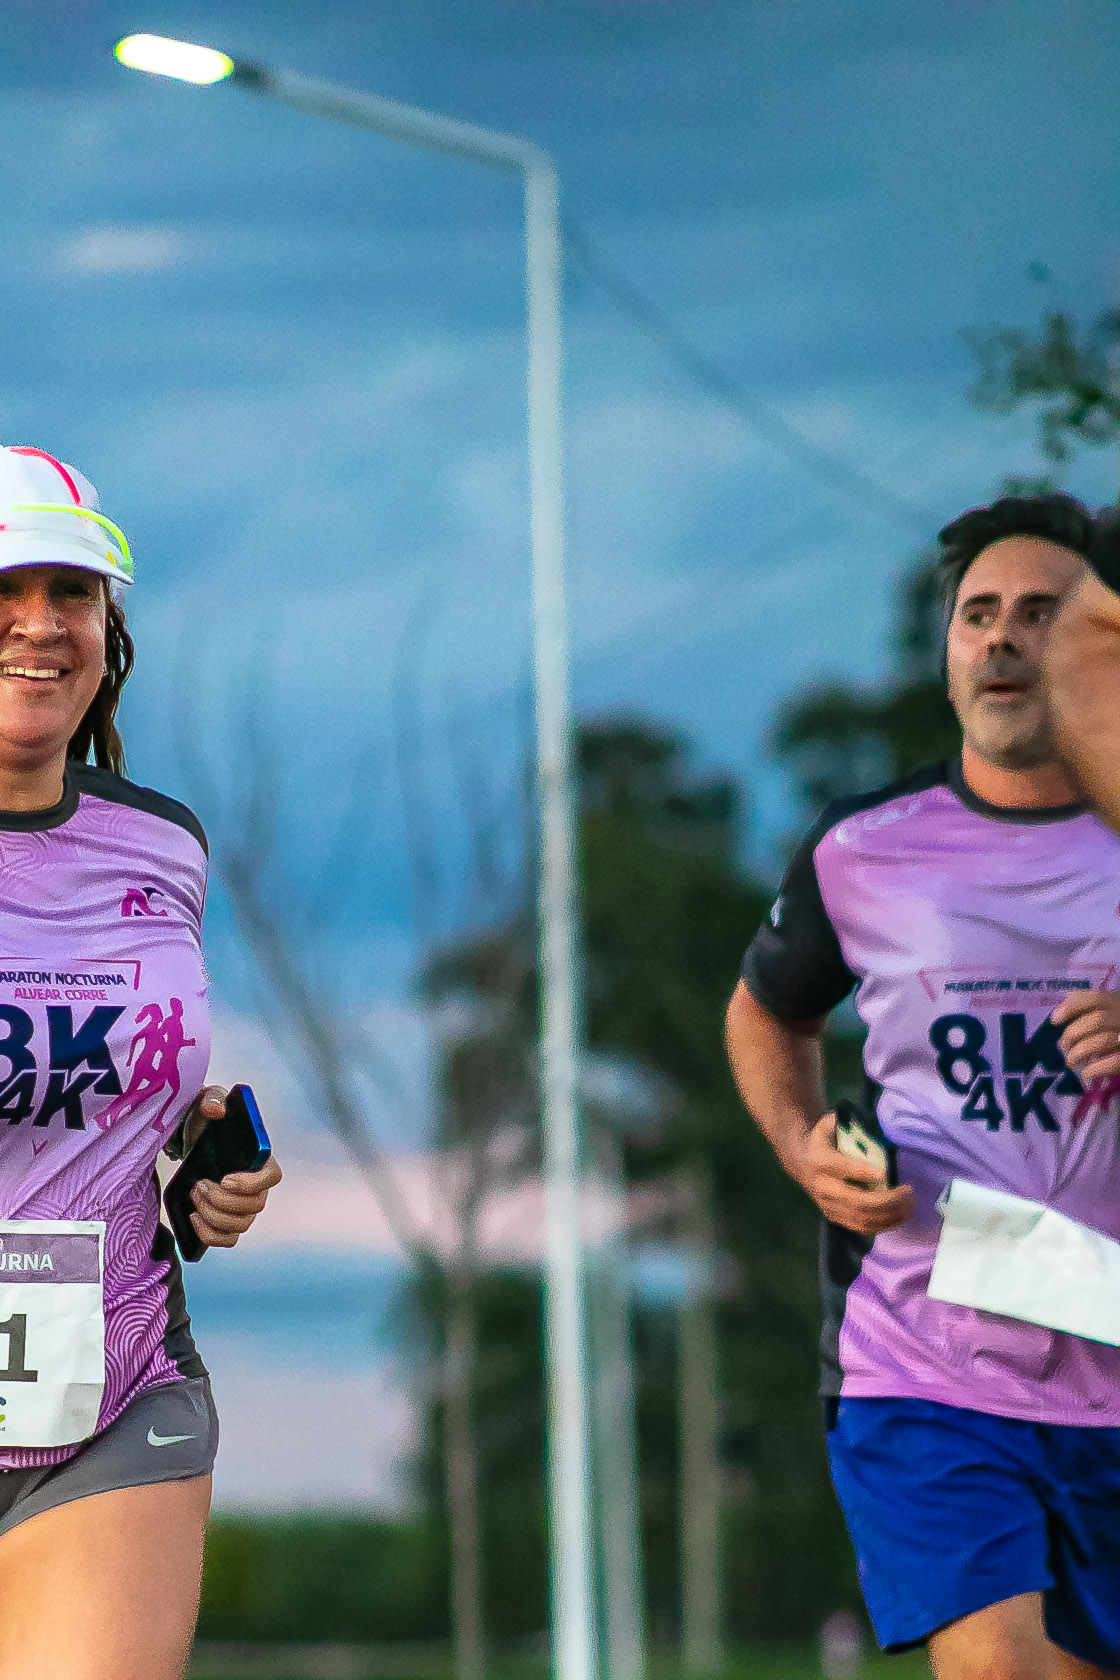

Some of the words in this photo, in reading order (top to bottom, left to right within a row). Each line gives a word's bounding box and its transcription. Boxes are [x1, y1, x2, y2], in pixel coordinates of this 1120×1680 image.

[14, 987, 61, 1000] ALVEAR
[65, 989, 108, 1001] CORRE
[55, 972, 127, 986] NOCTURNA
[930, 1012, 1086, 1096] 8K
[961, 1076, 1061, 1132] 4K
